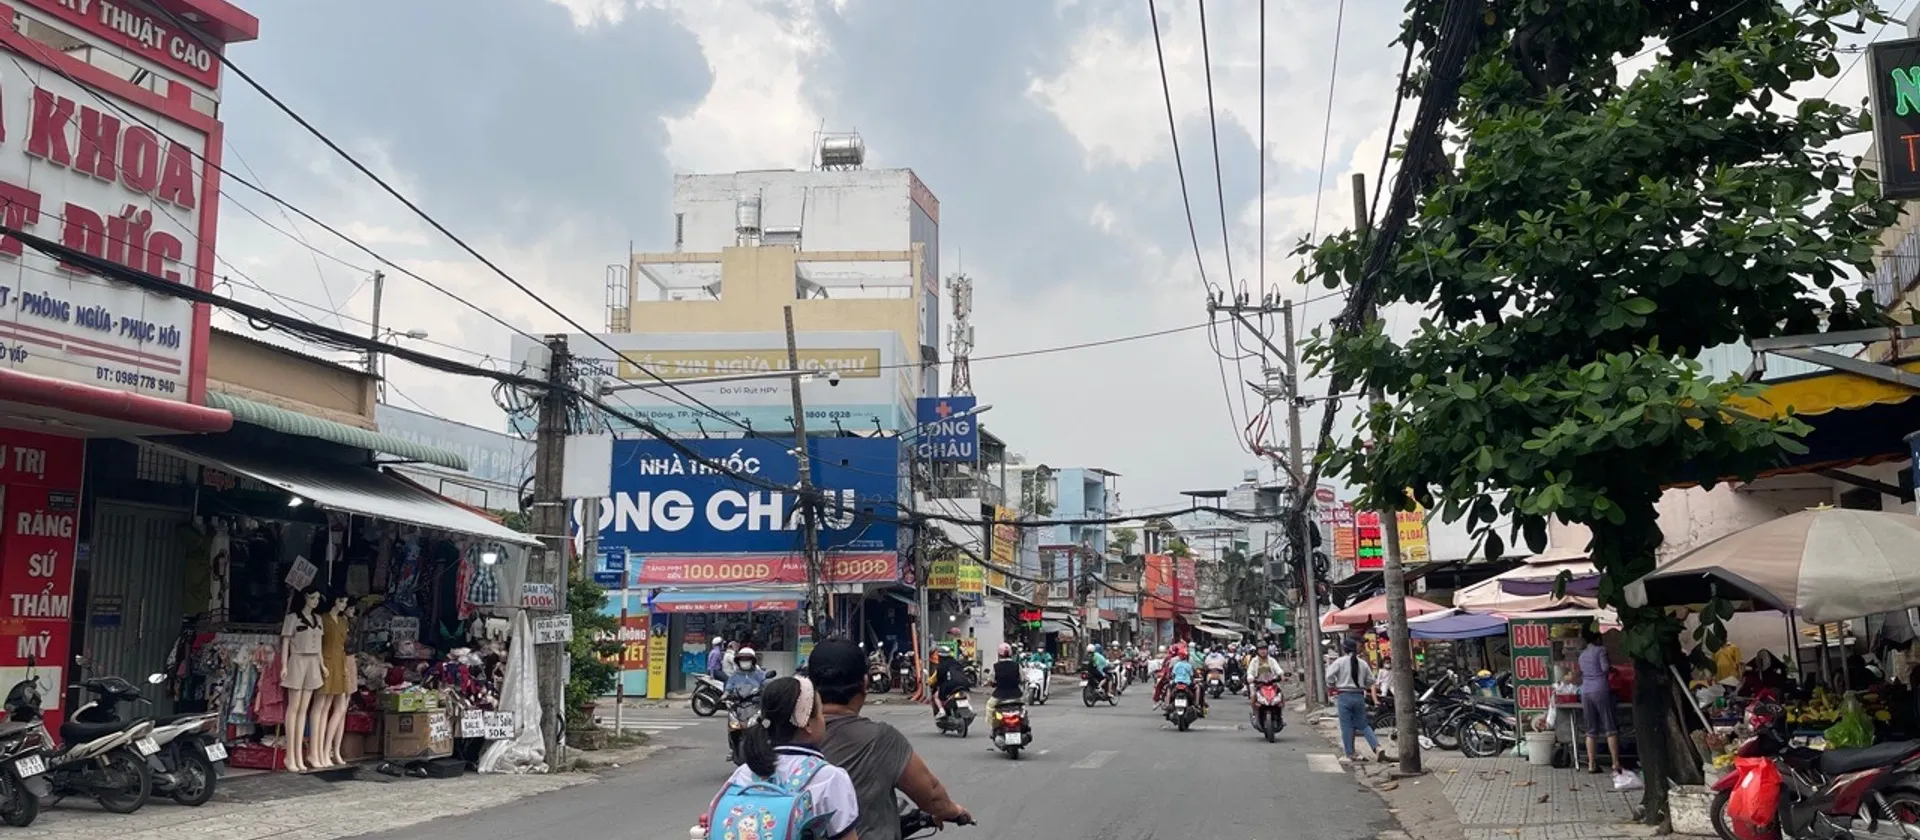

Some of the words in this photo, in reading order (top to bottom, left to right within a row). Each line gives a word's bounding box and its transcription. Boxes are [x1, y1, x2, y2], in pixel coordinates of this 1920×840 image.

[100, 1, 166, 48] THUẬT
[170, 36, 211, 73] CAO
[26, 86, 195, 209] KHOA
[59, 203, 182, 283] ĐỨC
[21, 290, 70, 321] PHÒNG
[76, 304, 111, 332] NGỪA
[120, 316, 155, 344] PHỤC
[675, 359, 708, 374] XIN
[115, 369, 138, 387] 0989
[140, 374, 156, 390] 778
[158, 378, 175, 394] 940
[760, 387, 779, 395] HPV
[918, 420, 970, 436] LONG
[918, 438, 972, 458] CHÂU
[14, 447, 46, 479] TRỊ
[640, 452, 685, 475] NHÀ
[17, 510, 73, 538] RĂNG
[572, 488, 695, 532] ONG
[28, 549, 58, 577] SỨ
[683, 563, 770, 580] 100.000Đ
[11, 583, 69, 617] THẨM
[16, 630, 51, 658] MỸ
[1513, 621, 1550, 648] BÚN
[1516, 656, 1549, 680] CUA
